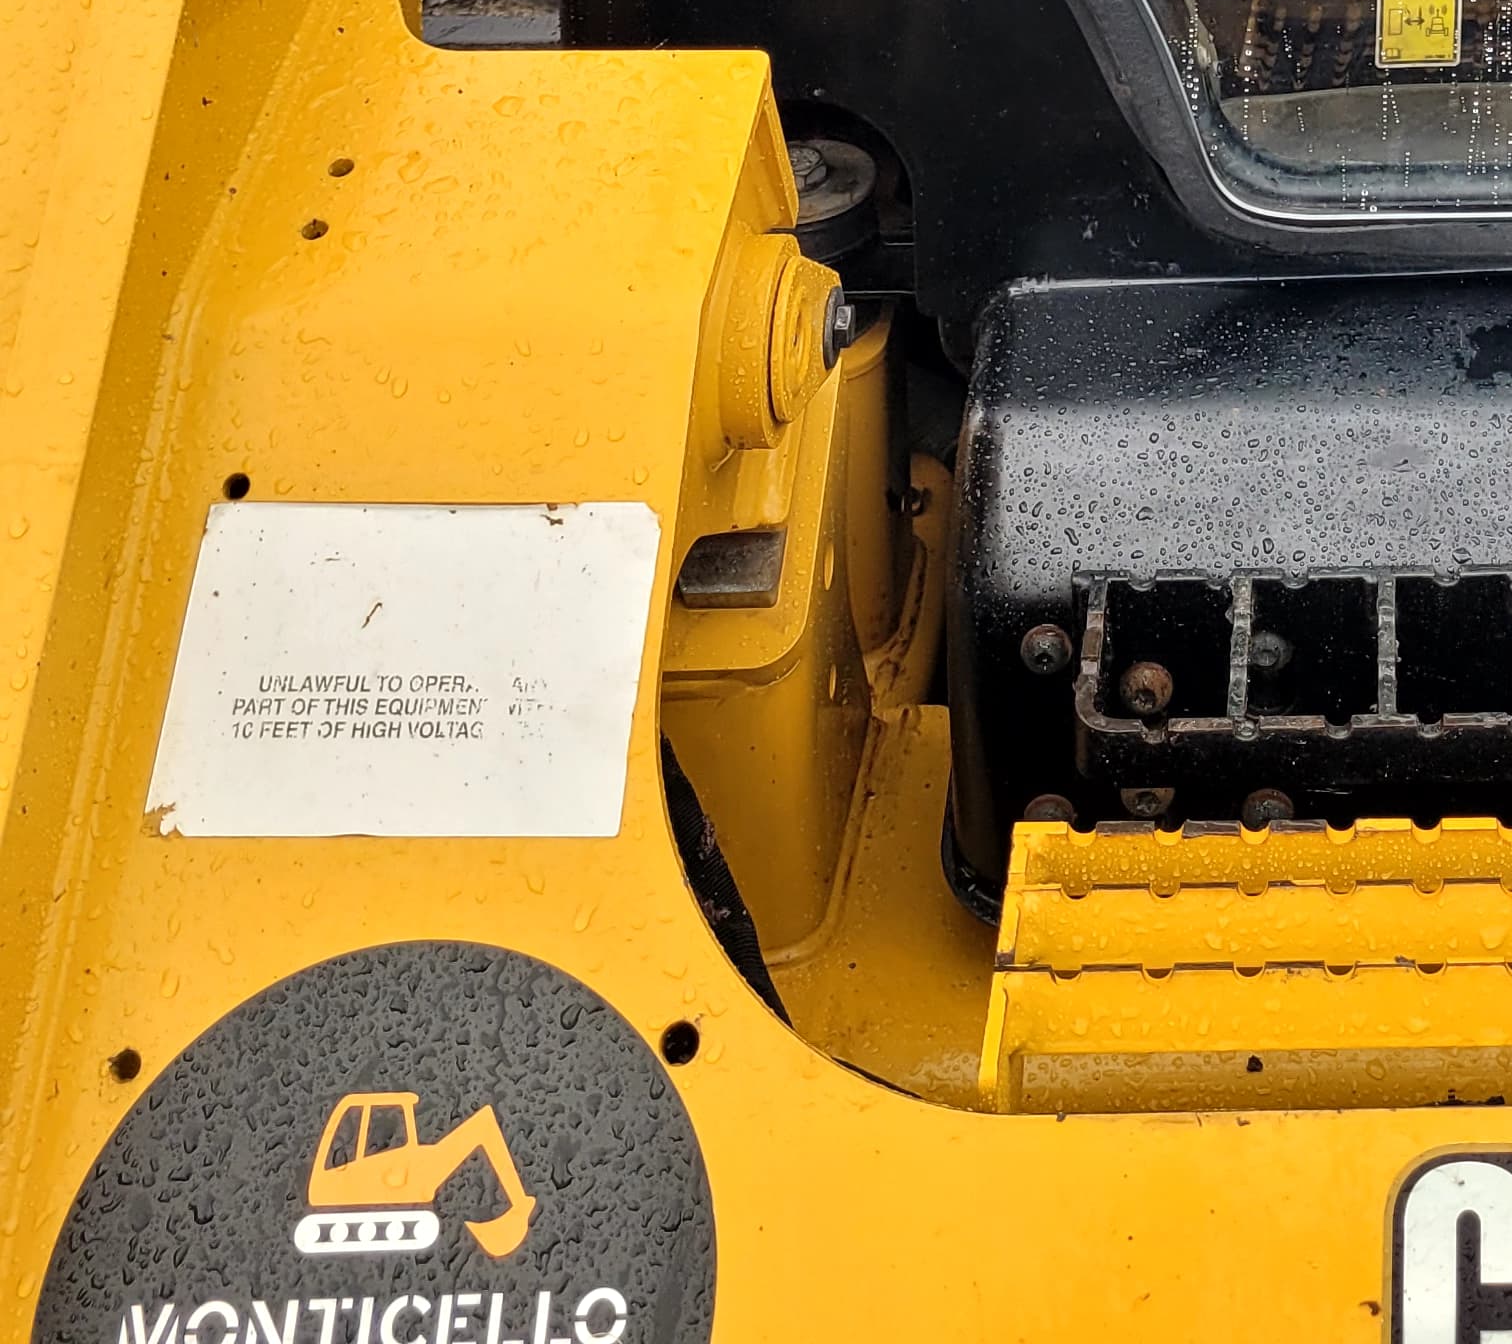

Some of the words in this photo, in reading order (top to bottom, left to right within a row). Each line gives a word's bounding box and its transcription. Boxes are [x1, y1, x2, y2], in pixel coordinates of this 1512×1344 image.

[259, 675, 371, 693] UNLAWFUL
[376, 675, 402, 692] TO
[232, 698, 286, 716] PART
[291, 698, 320, 716] OF
[324, 698, 369, 715] THIS
[374, 698, 488, 716] EQUIPMEN
[259, 721, 313, 739] FEET
[317, 721, 346, 739] OF
[351, 721, 402, 739] HIGH
[118, 1287, 628, 1344] MONTICELLO
